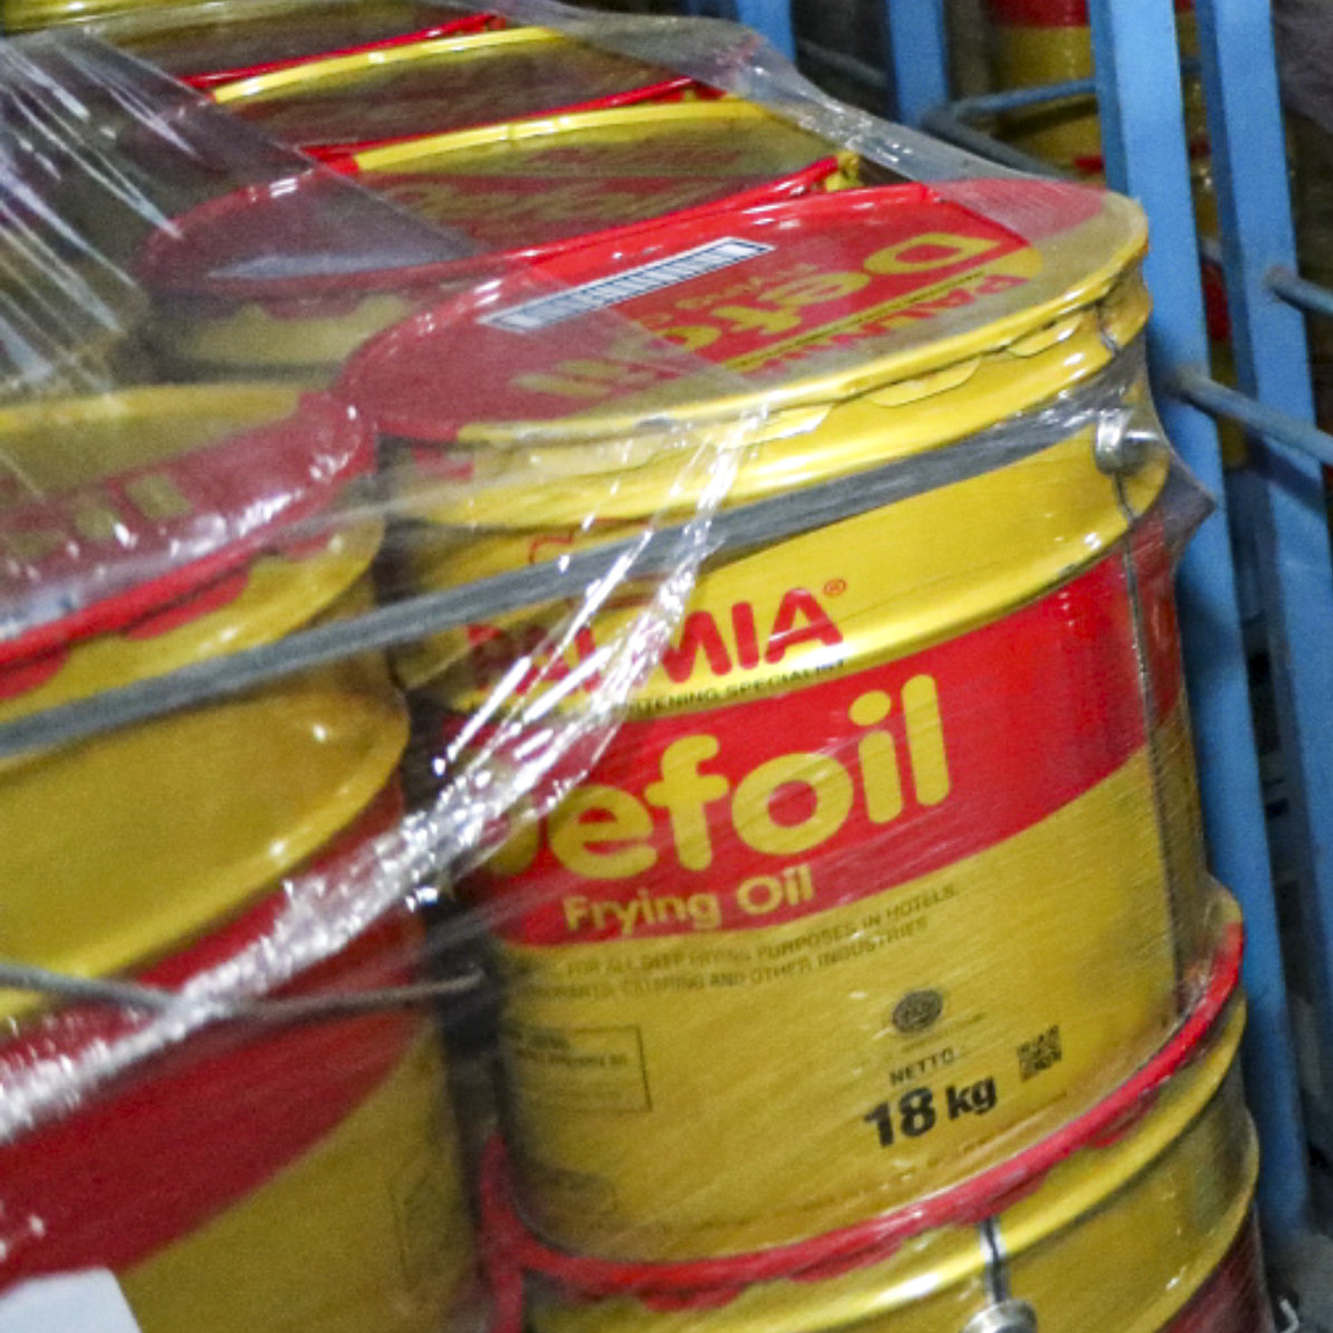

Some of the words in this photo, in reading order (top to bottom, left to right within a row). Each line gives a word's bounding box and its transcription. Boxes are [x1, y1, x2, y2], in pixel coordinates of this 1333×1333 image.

[563, 887, 722, 935] Frying
[736, 865, 815, 916] Oil
[756, 920, 857, 960] PURPOSES
[862, 913, 882, 929] IN
[750, 955, 813, 985] OTHER
[889, 1047, 954, 1087] NETTO
[862, 1086, 937, 1149] 18
[944, 1074, 998, 1122] kg
